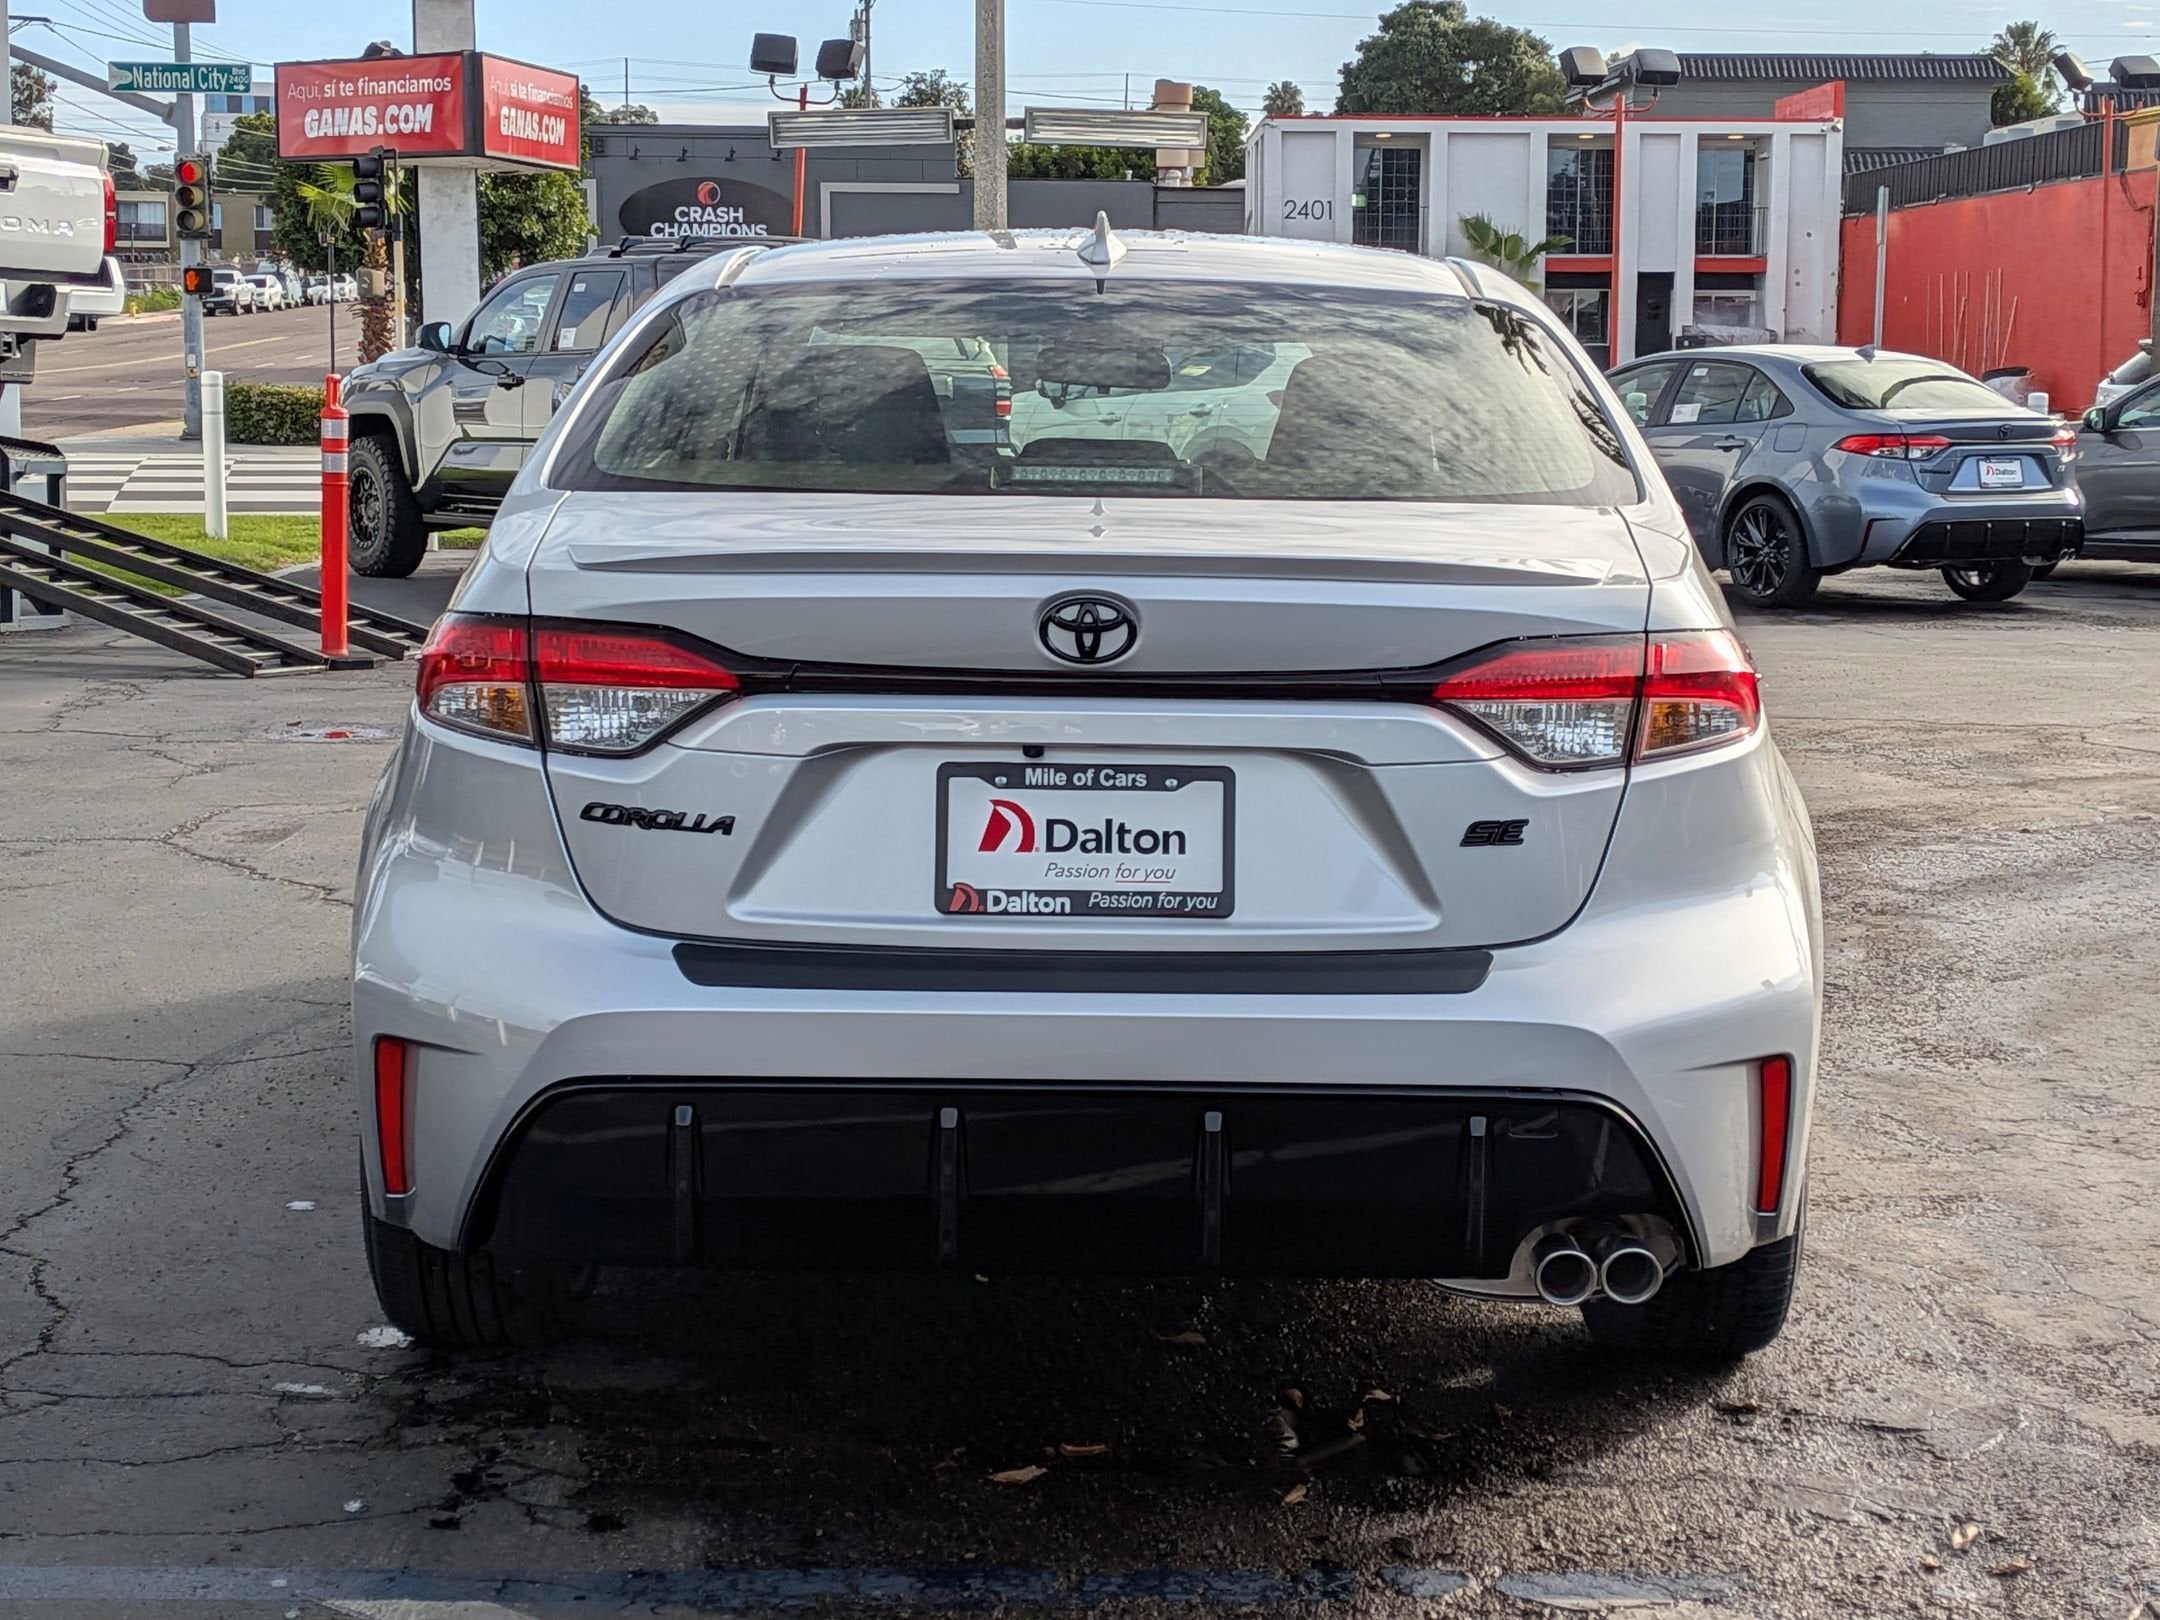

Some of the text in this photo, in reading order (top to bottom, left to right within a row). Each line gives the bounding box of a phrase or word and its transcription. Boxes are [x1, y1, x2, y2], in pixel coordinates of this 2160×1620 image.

[132, 65, 228, 91] National City
[228, 75, 249, 84] 2400
[287, 74, 452, 103] Aquí, sí te financiamos
[303, 103, 434, 139] GANAS.COM
[500, 106, 566, 146] GANAS.COM
[674, 206, 744, 223] CRASH
[1284, 199, 1332, 221] 2401
[650, 222, 768, 238] CHAMPIONS
[1024, 768, 1148, 787] Mile of Cars
[579, 802, 736, 836] COROLLA
[1045, 818, 1187, 855] Dalton
[1459, 818, 1530, 847] SE
[1044, 862, 1177, 882] Passion for you
[986, 890, 1071, 914] Dalton
[1087, 892, 1218, 911] Passion for you
